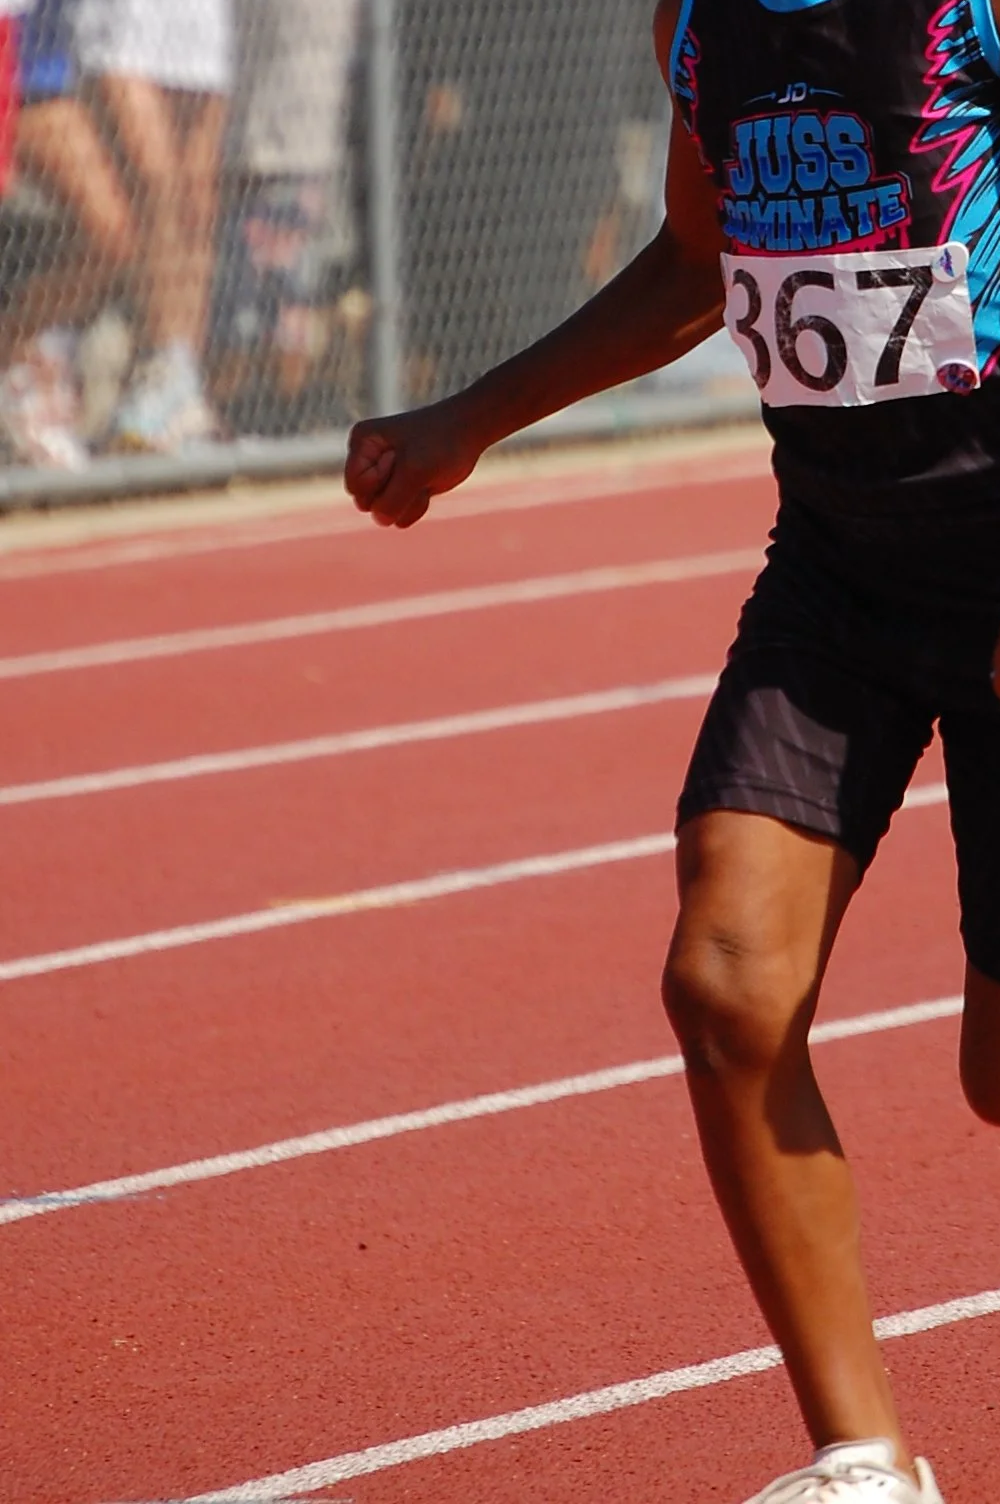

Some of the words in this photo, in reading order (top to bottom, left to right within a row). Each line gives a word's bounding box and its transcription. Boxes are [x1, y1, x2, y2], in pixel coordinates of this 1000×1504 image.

[777, 82, 807, 103] JD
[729, 114, 871, 196] JUSS
[723, 183, 906, 251] DOMINATE
[732, 265, 934, 392] 367
